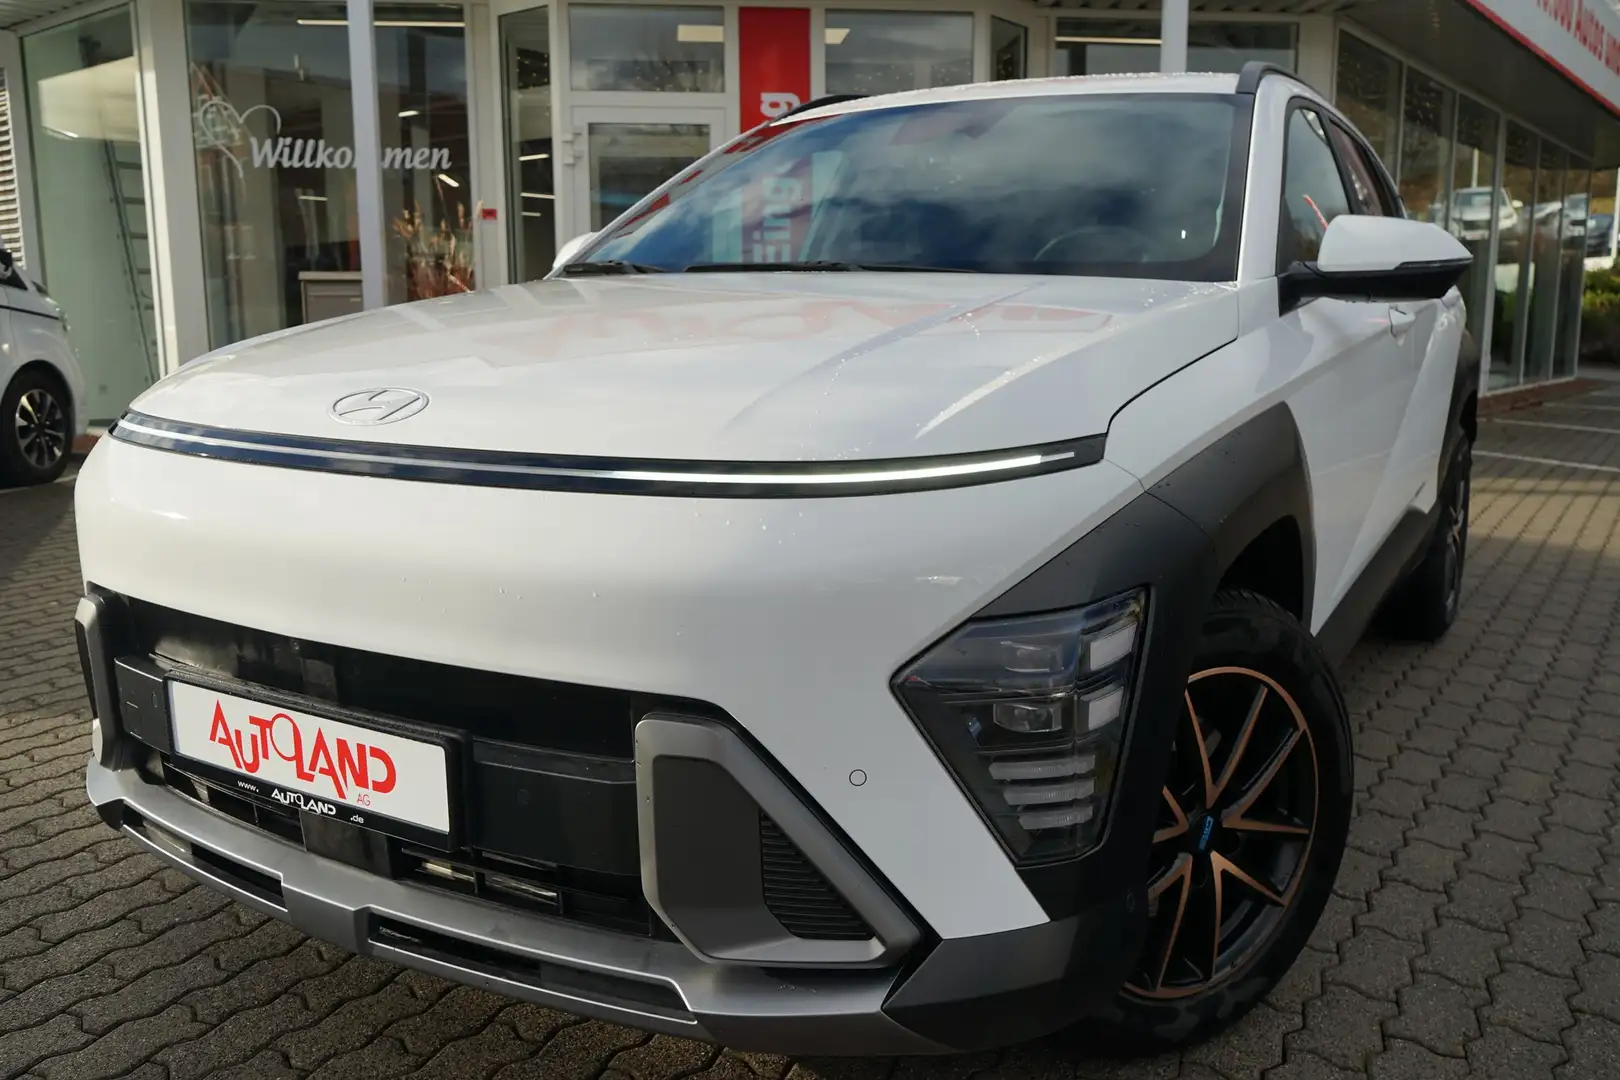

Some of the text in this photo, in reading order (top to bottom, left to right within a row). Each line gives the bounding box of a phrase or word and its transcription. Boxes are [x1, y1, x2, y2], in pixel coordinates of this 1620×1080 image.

[250, 136, 452, 169] Willkomen
[237, 780, 259, 792] www.
[350, 813, 365, 824] .de
[356, 793, 371, 807] AG
